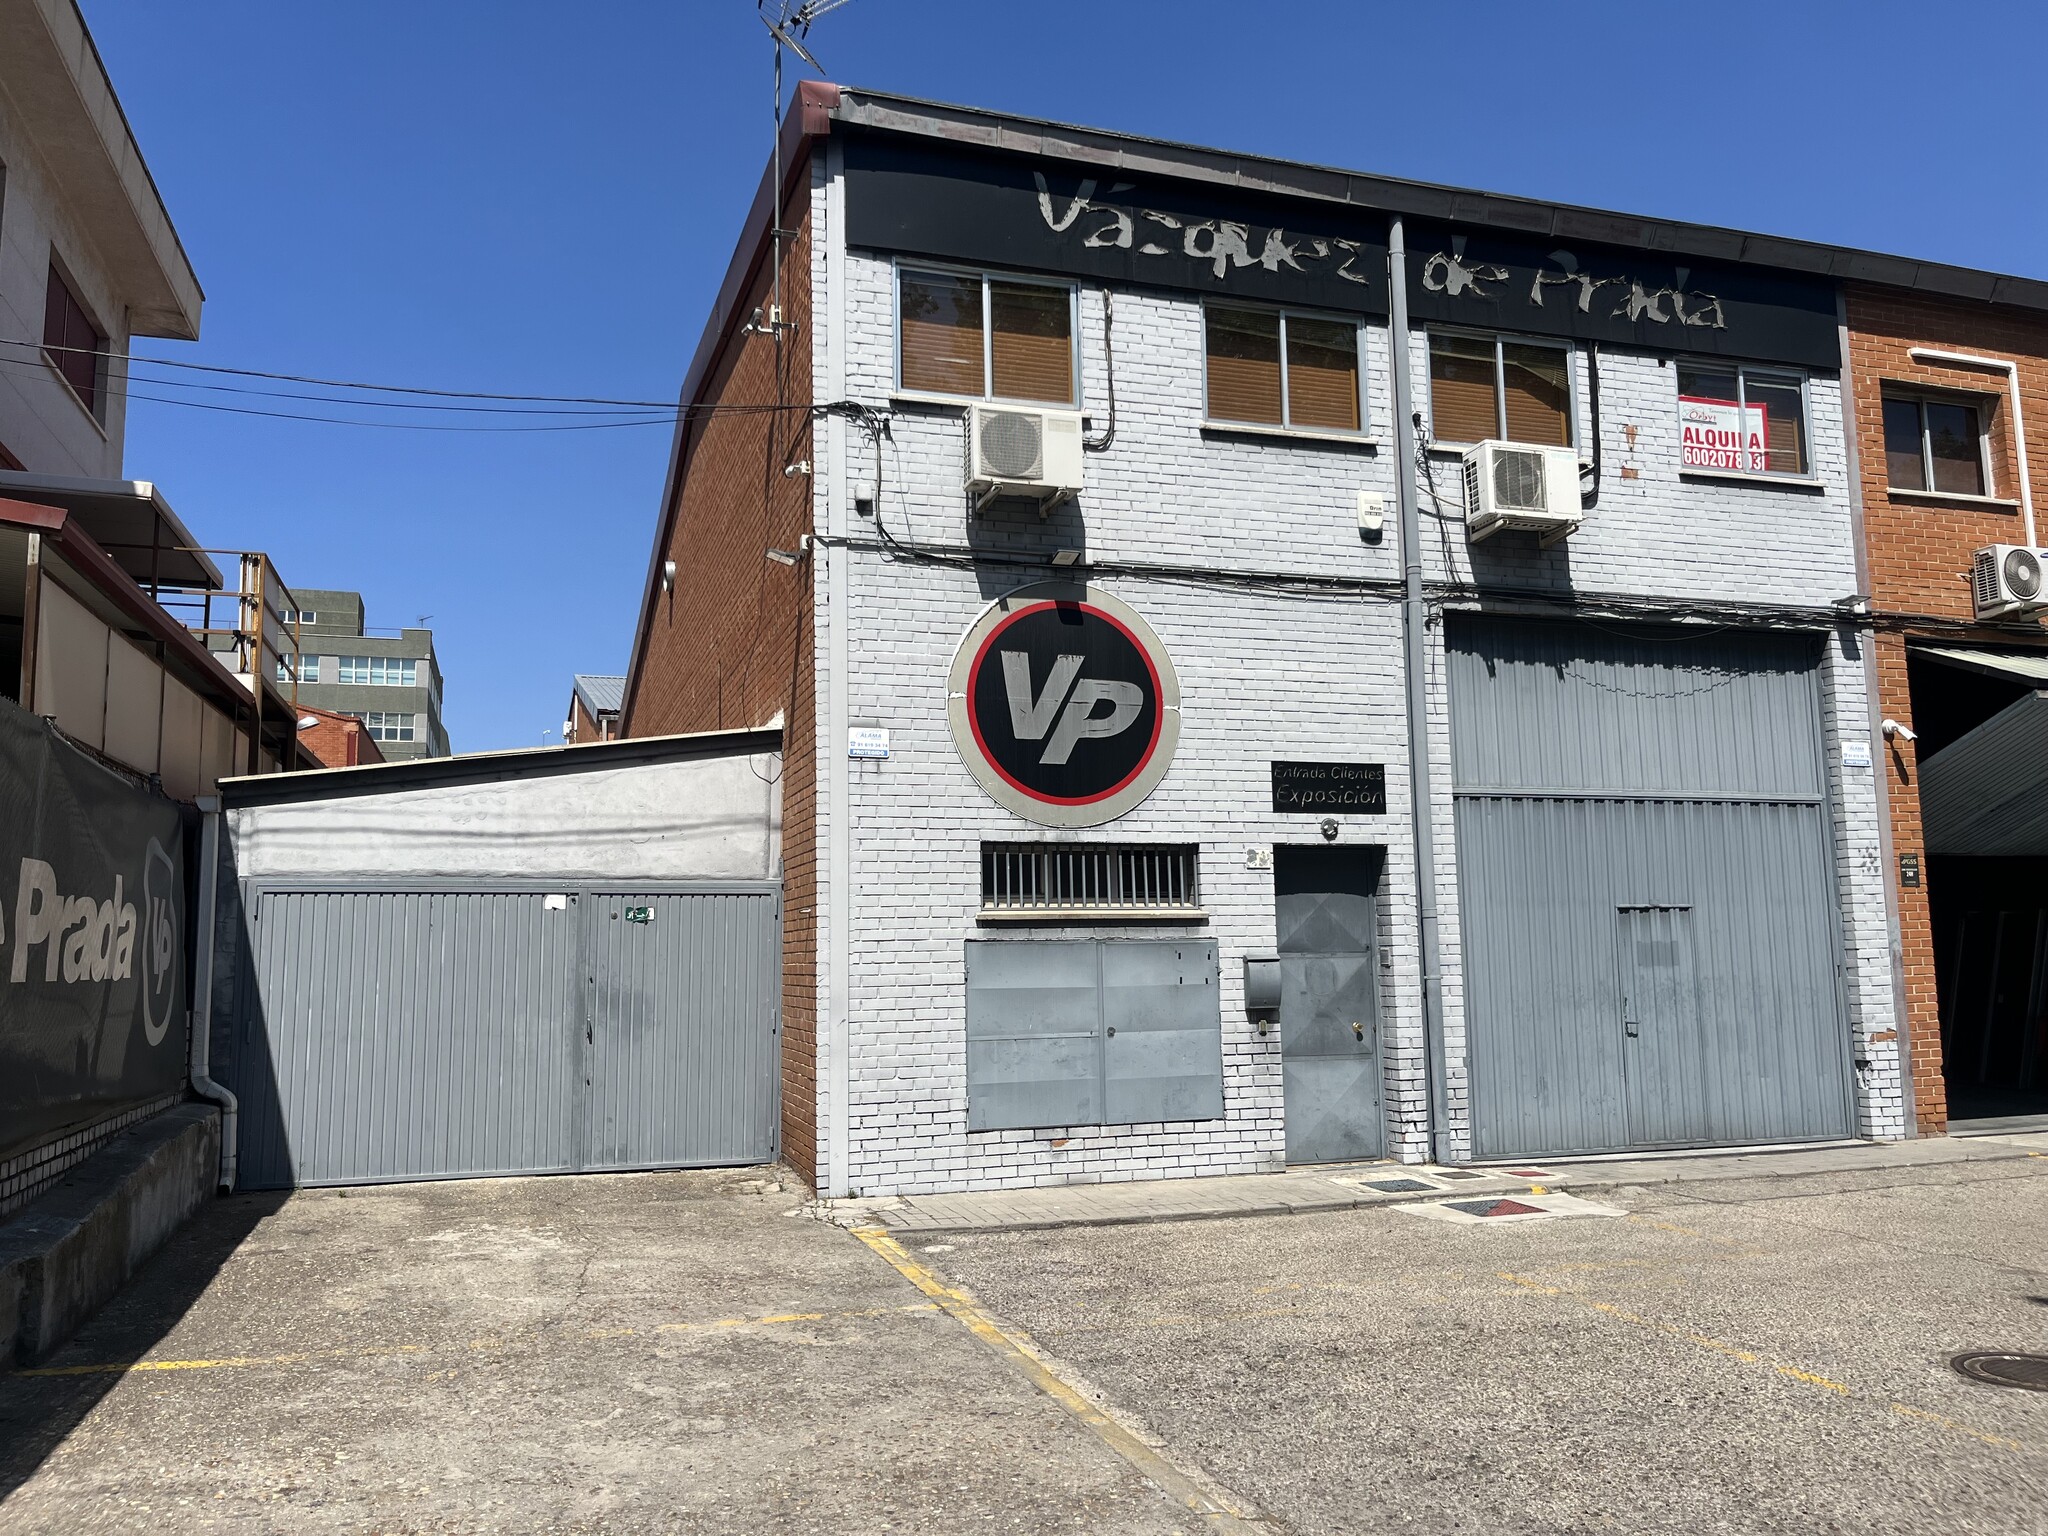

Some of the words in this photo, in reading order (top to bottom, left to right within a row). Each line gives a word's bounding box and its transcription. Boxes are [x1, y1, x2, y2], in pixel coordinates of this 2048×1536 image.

[1001, 650, 1144, 765] VP
[1274, 765, 1326, 779] Entrada
[1331, 766, 1383, 780] Clientes
[1276, 784, 1384, 808] Exposición
[10, 857, 137, 984] Prada
